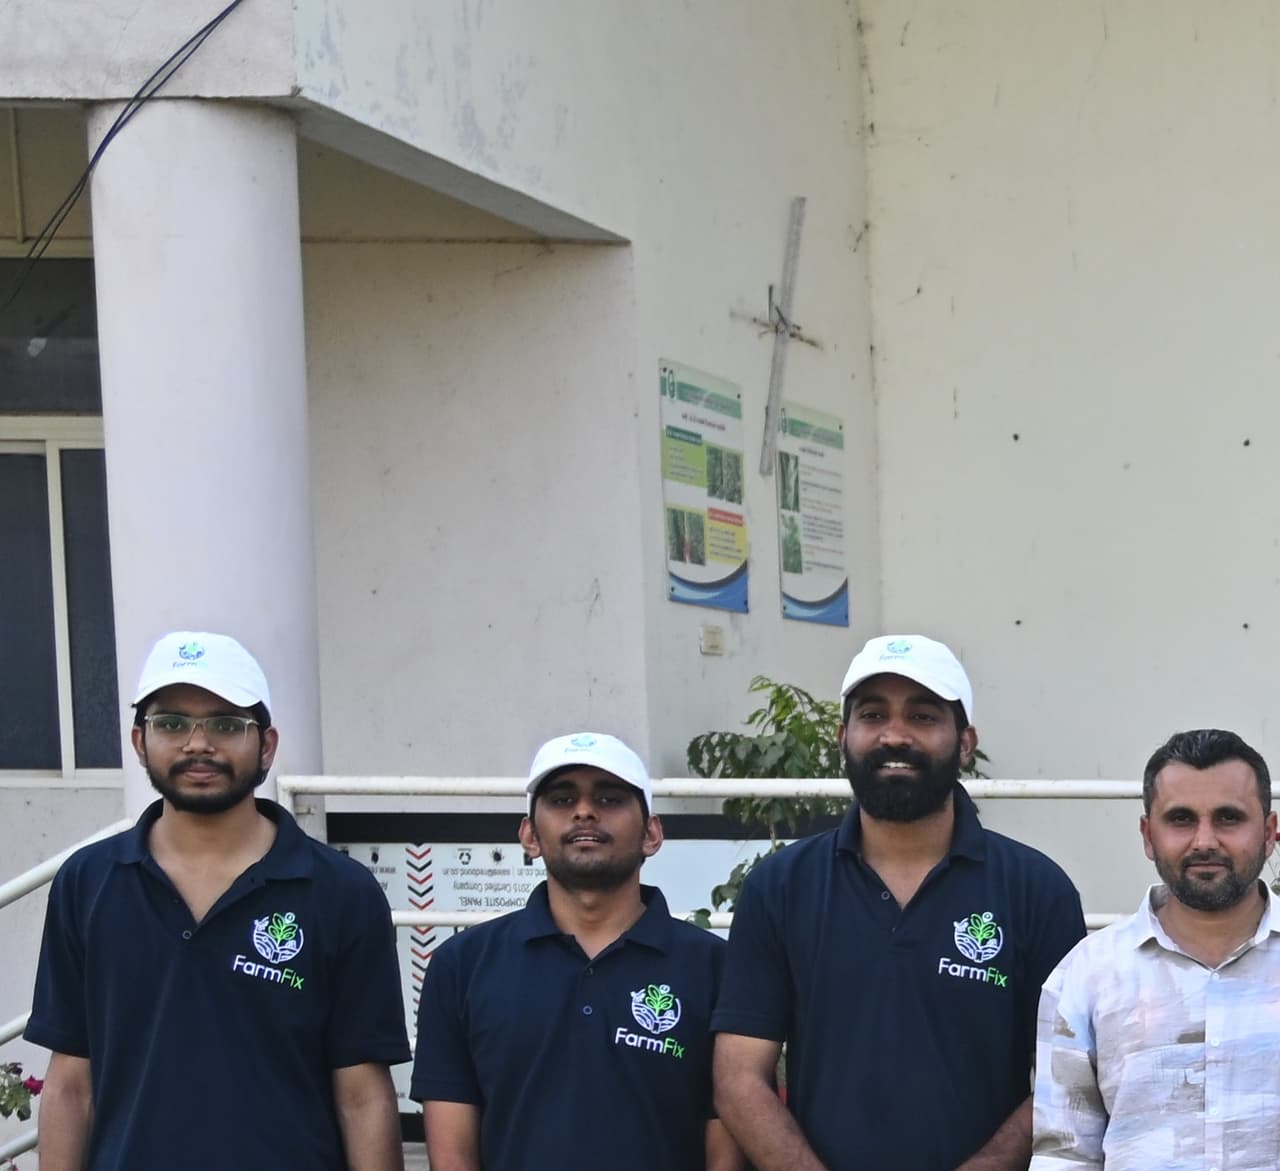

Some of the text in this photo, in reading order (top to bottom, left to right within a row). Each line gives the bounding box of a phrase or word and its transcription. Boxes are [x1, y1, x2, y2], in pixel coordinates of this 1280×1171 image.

[453, 880, 483, 892] Company
[484, 882, 512, 893] Certified
[458, 897, 527, 907] COMPOSITE PANEL
[232, 954, 306, 991] FarmFix
[938, 957, 1009, 989] FarmFix
[614, 1027, 686, 1060] FarmFix
